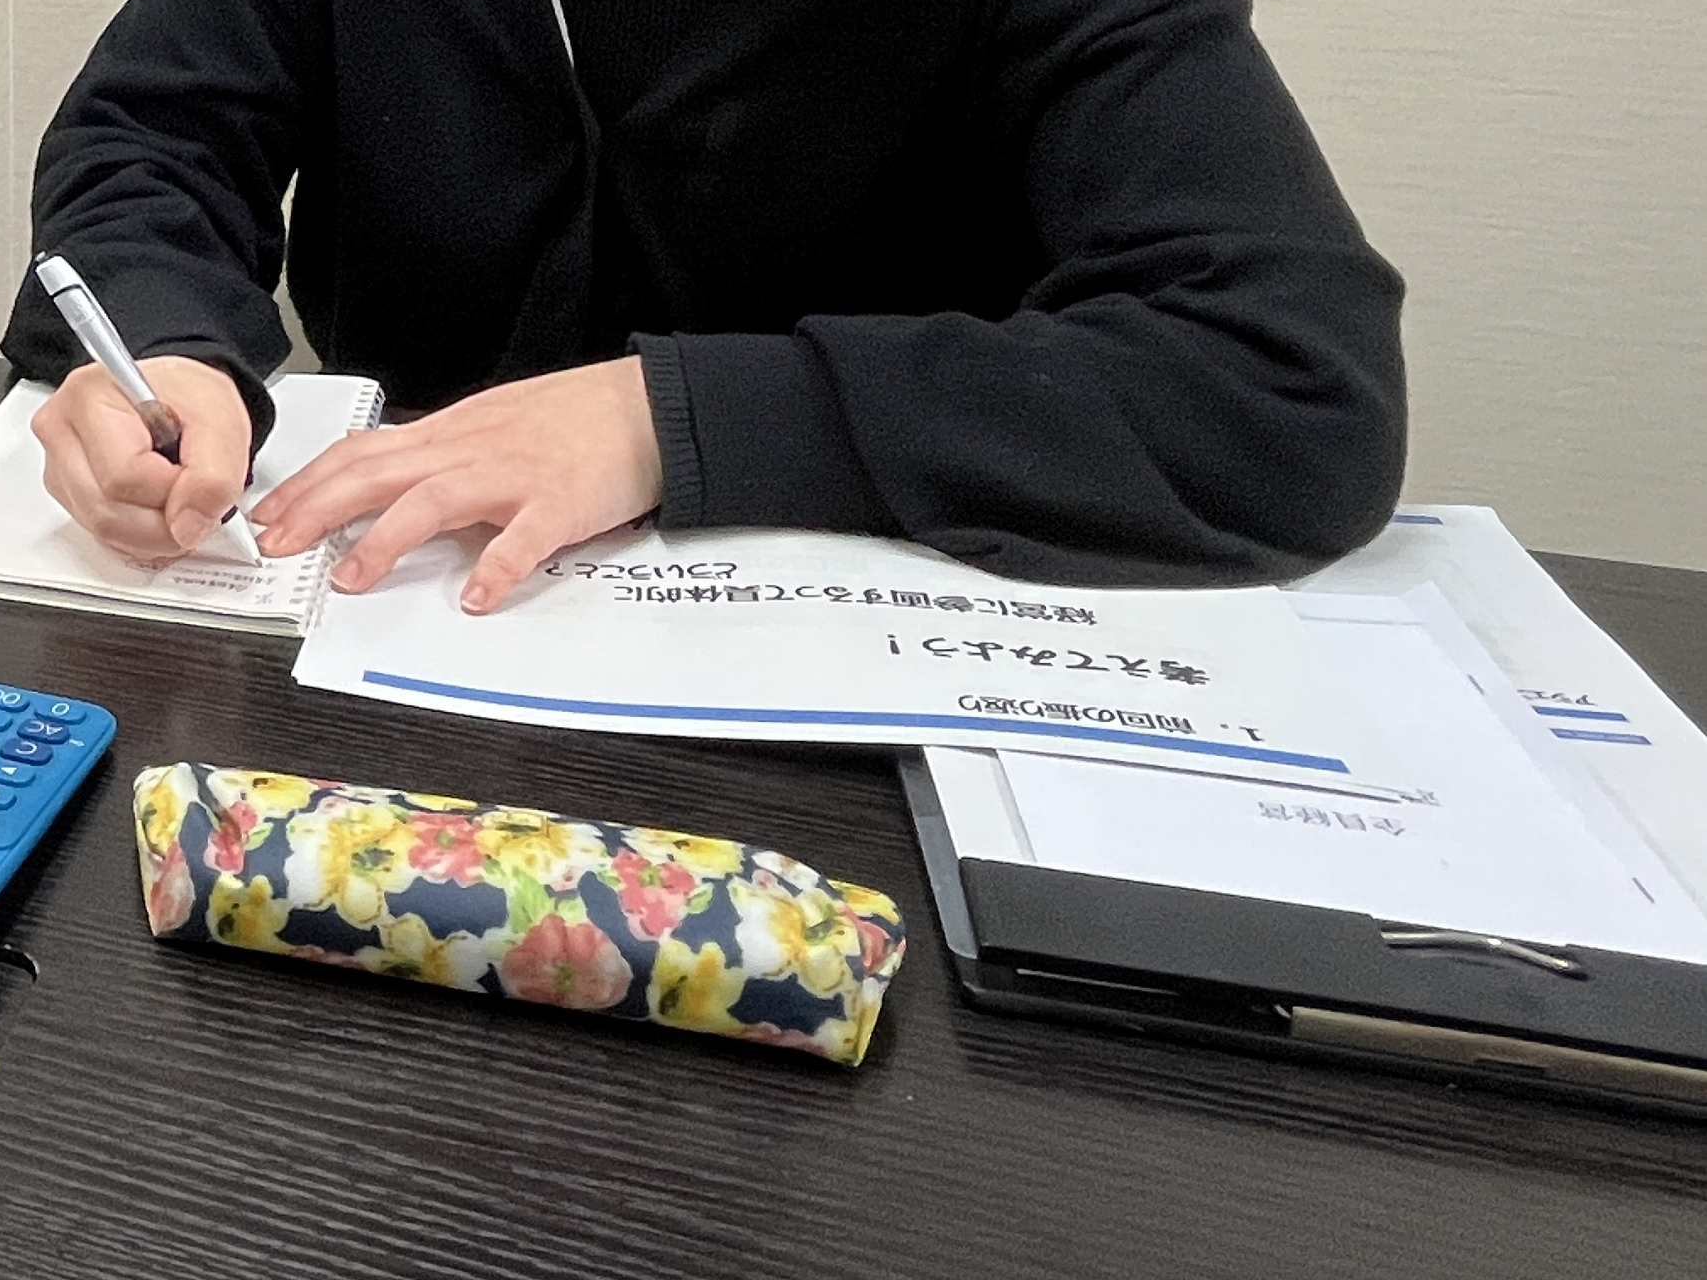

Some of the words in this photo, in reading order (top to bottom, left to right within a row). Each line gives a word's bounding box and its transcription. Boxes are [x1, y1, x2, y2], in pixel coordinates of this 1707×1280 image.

[613, 585, 1097, 627] 経営に参画するって具体的に
[886, 633, 1210, 685] 考えてみよう！
[24, 720, 63, 736] AC
[957, 694, 1196, 735] 前回の振り返り
[15, 740, 38, 755] C
